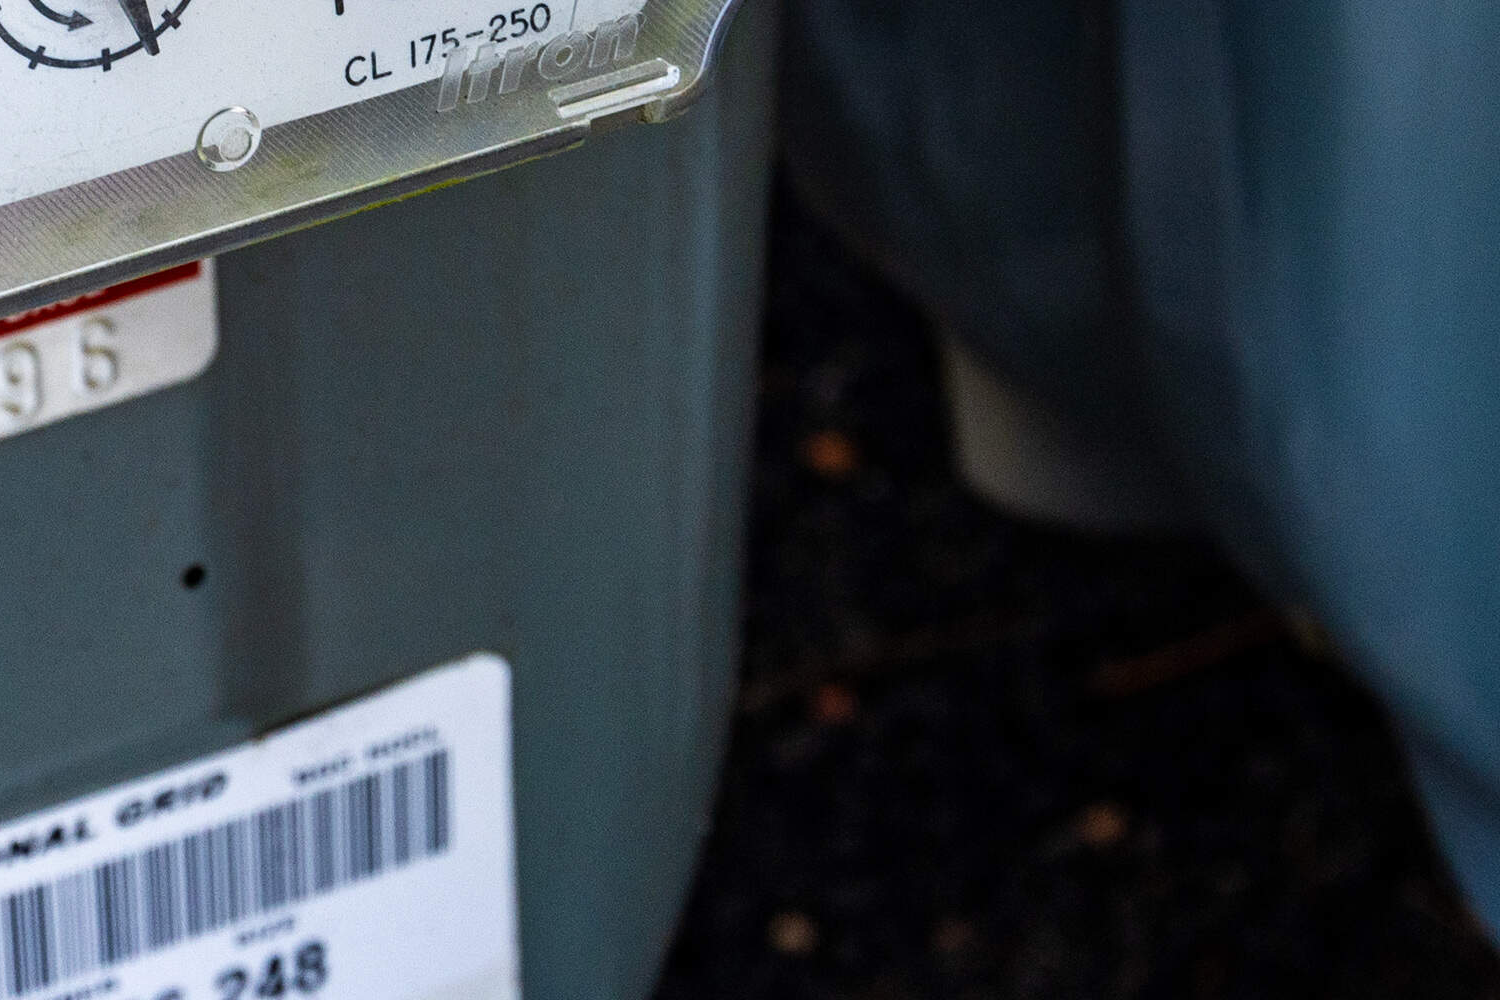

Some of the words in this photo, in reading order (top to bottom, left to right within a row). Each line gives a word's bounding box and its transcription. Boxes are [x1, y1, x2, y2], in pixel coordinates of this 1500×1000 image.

[343, 50, 393, 87] CL
[409, 1, 552, 69] 175-250
[115, 770, 229, 829] GRID
